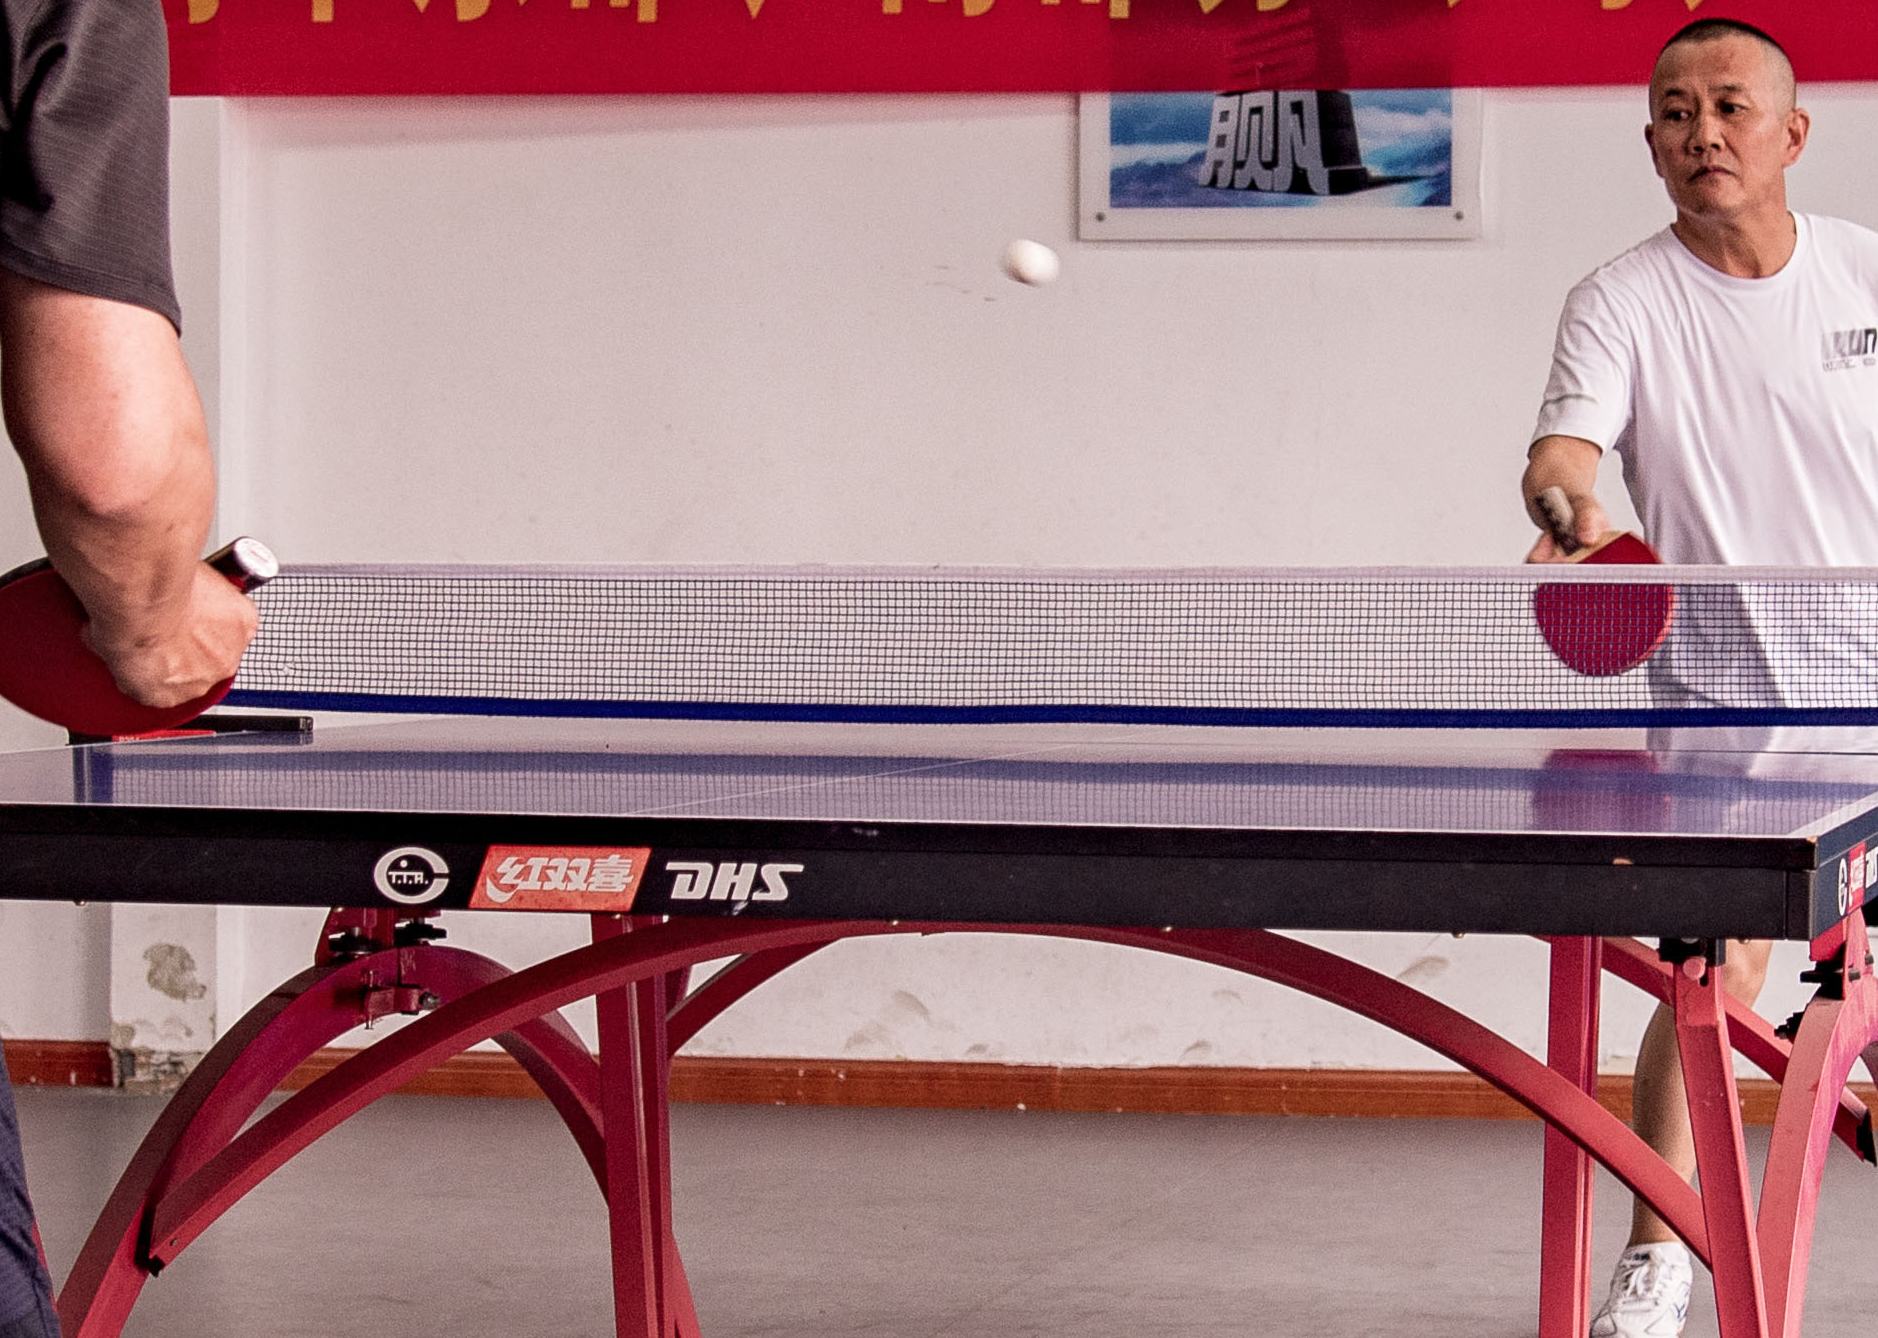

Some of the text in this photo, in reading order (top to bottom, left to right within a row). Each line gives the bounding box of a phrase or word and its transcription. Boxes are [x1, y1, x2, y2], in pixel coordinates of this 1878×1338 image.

[485, 854, 804, 903] 红双喜 DHS
